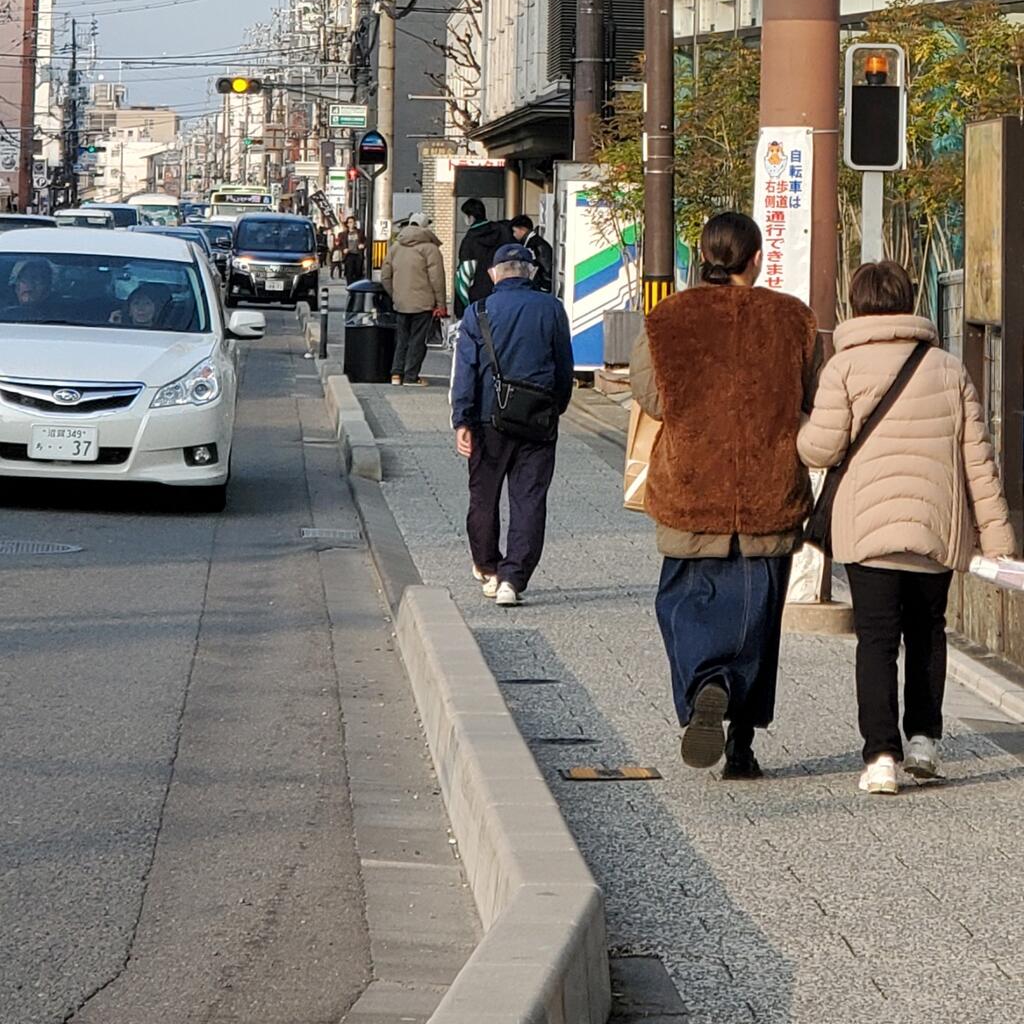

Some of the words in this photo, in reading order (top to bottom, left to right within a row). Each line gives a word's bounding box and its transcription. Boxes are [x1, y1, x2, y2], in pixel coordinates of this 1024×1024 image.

[789, 150, 802, 208] 自転車は
[765, 180, 775, 209] 右側
[776, 180, 788, 209] 歩道
[765, 210, 786, 289] 通行できませ
[66, 429, 82, 438] 349
